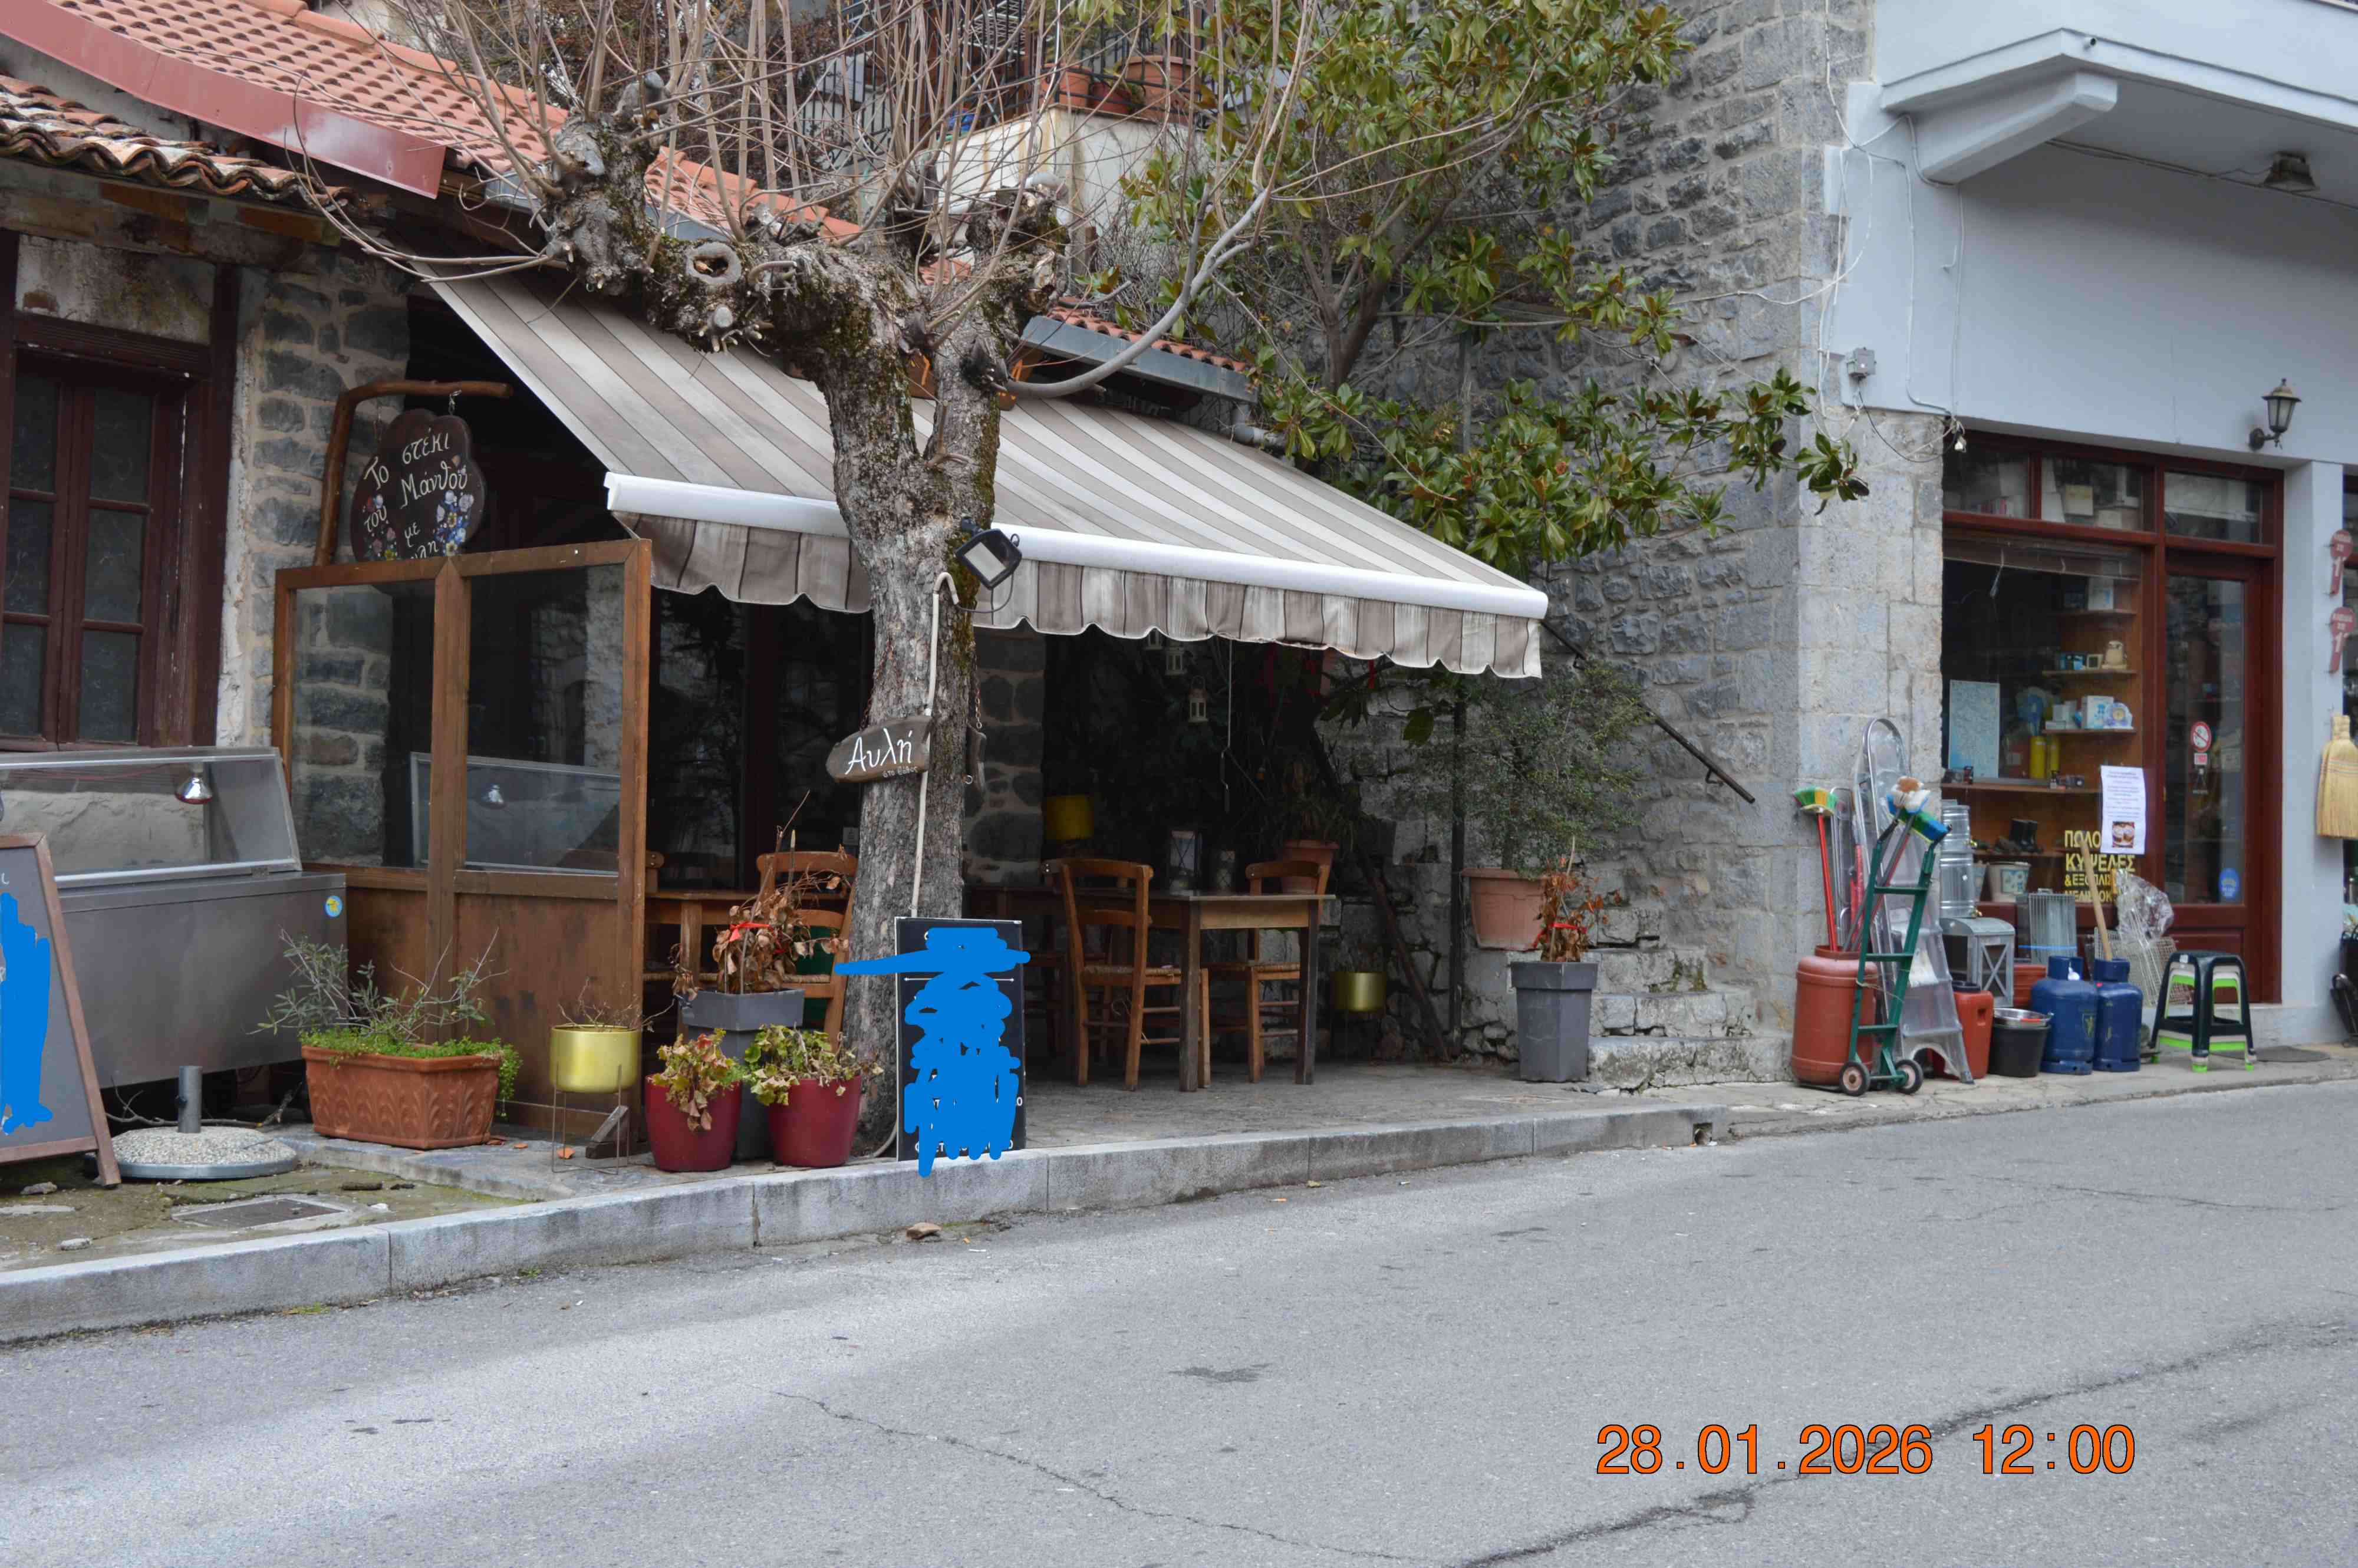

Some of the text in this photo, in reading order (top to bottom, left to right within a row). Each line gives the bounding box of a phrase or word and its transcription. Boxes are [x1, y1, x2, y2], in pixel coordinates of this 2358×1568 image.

[364, 456, 389, 490] Το
[364, 505, 387, 532] του
[404, 521, 420, 548] με
[845, 727, 914, 775] Αυλή
[2064, 829, 2102, 848] ΠΩΛΟ
